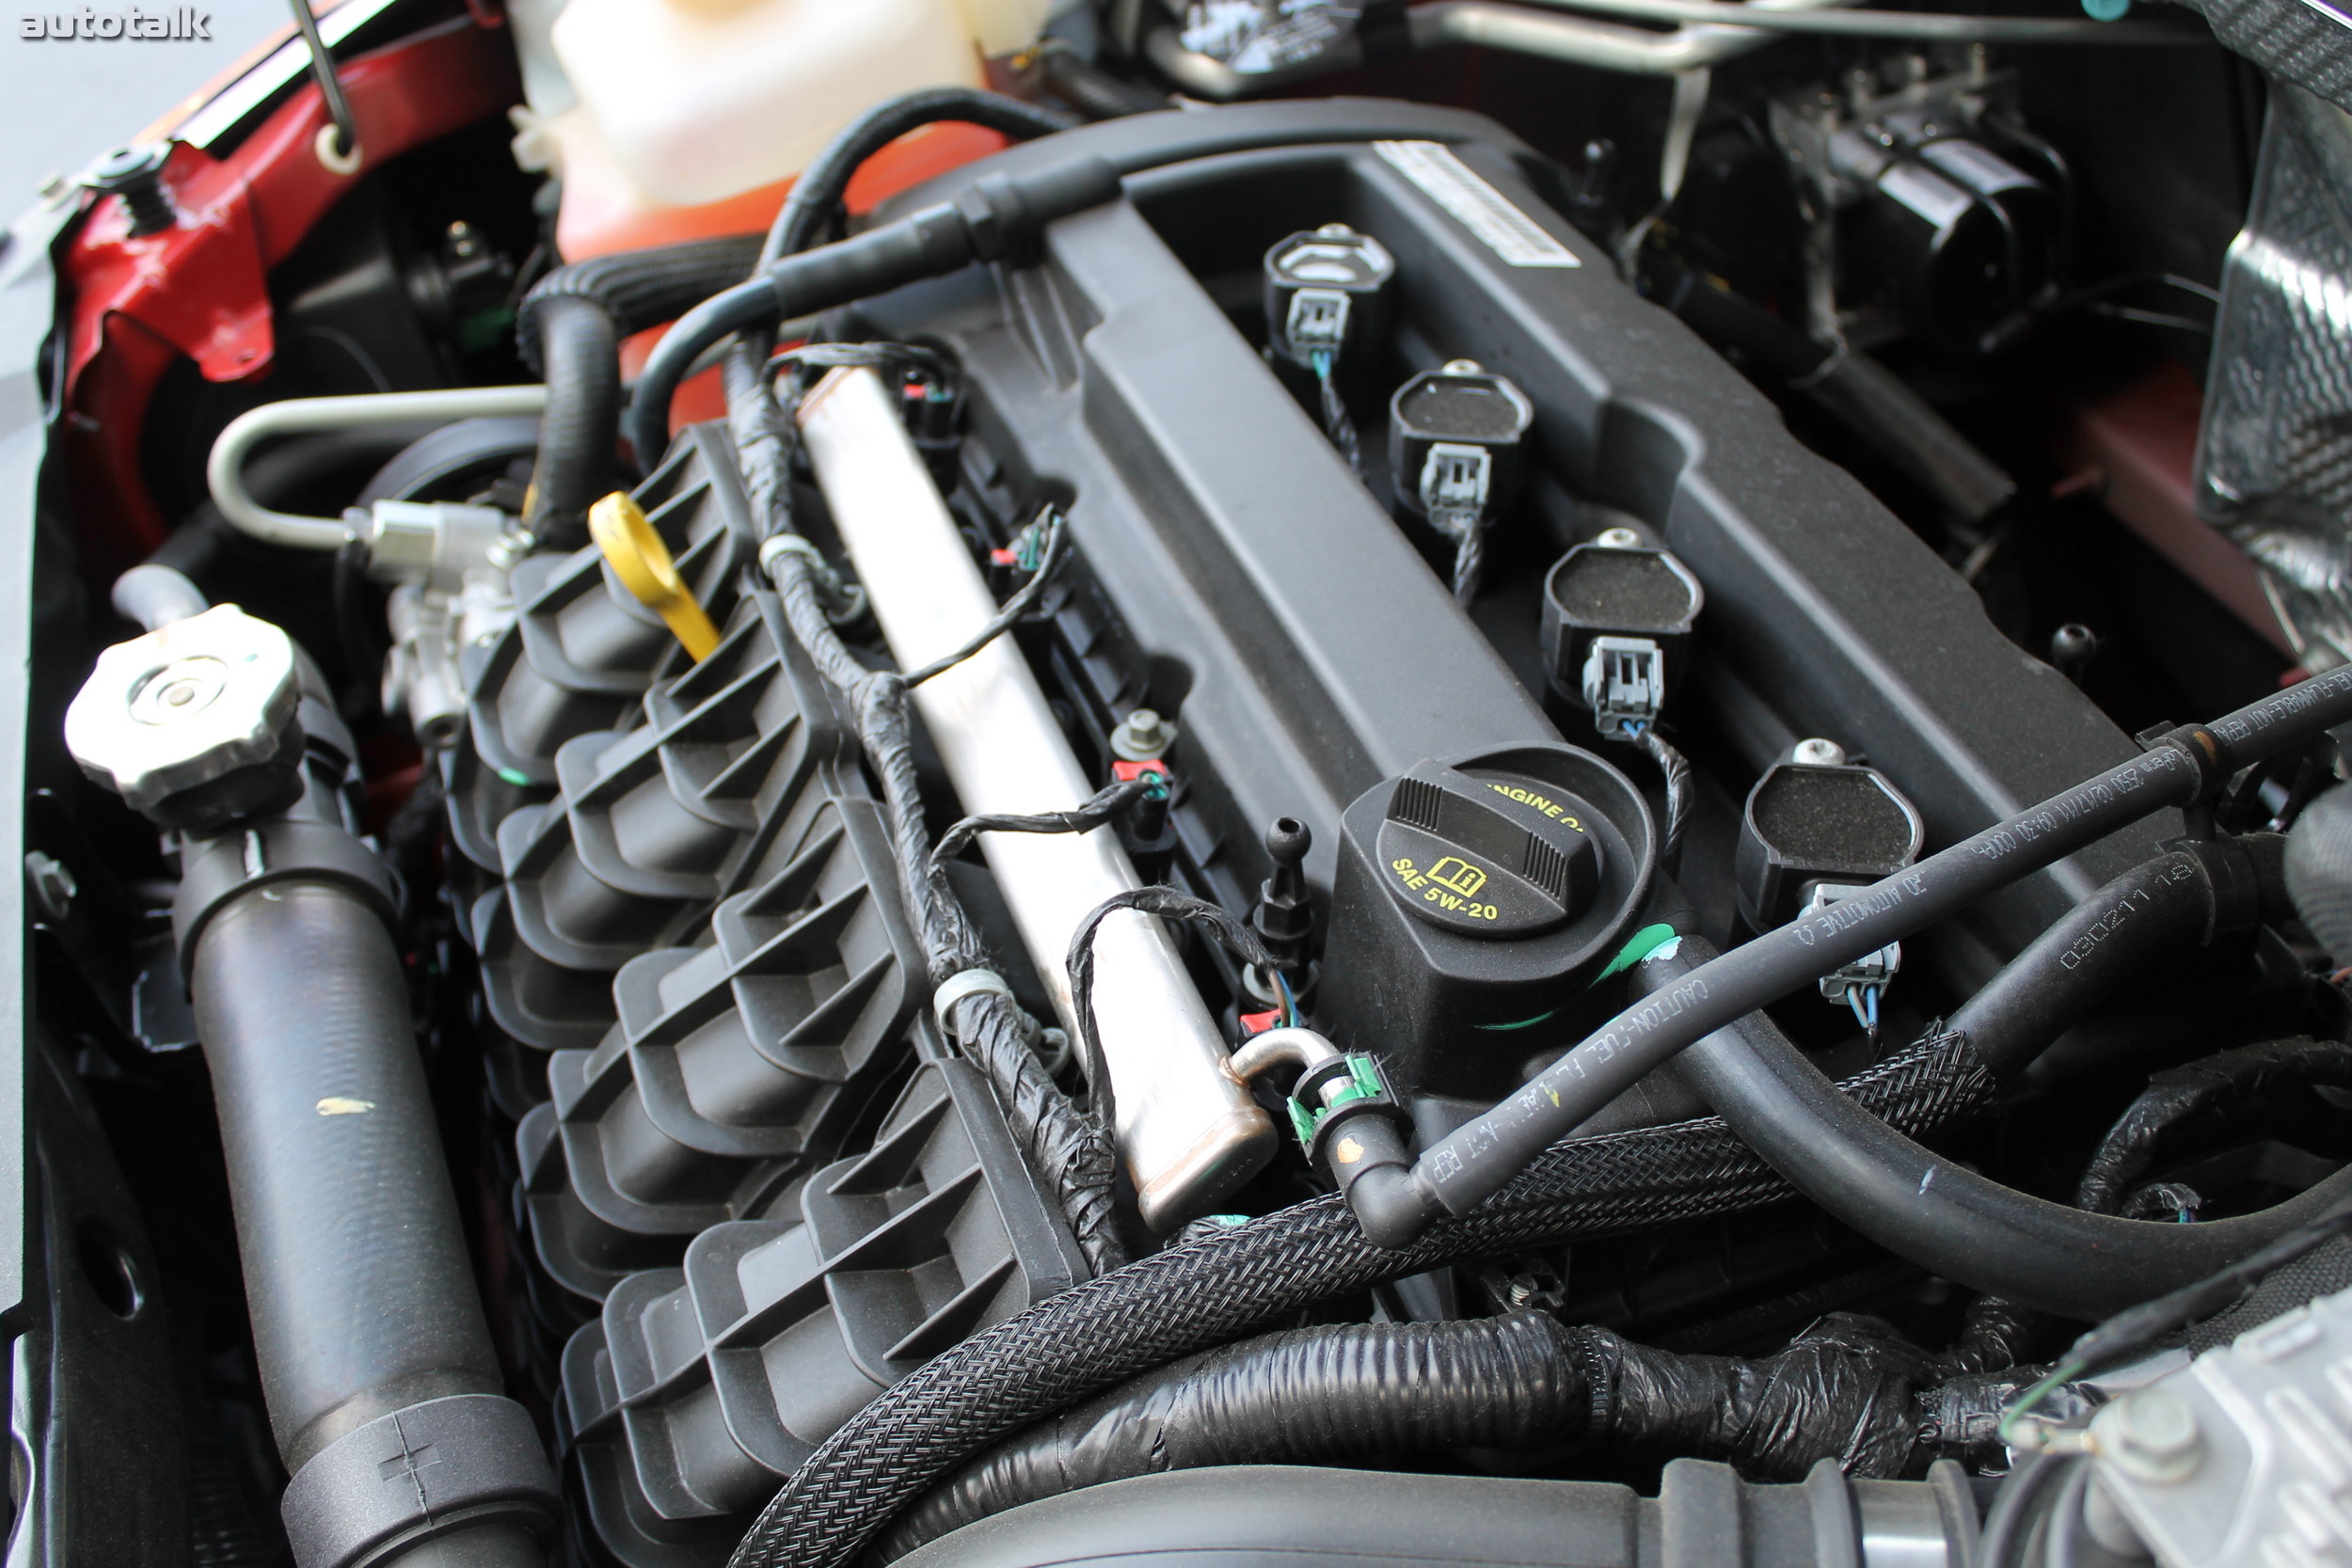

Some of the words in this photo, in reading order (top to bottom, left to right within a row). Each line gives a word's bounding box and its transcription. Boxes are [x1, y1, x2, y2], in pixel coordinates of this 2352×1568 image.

[2249, 669, 2352, 731] UEL-FLAMMABLE-NOT
[2214, 718, 2252, 746] REPAI
[2110, 768, 2145, 794] 2550
[2055, 783, 2114, 822] 02/17/11
[2015, 811, 2058, 842] 09:30
[1391, 858, 1429, 891] SAE
[1423, 886, 1499, 921] 5W-20
[1816, 885, 1902, 938] AUTOMOTIVE
